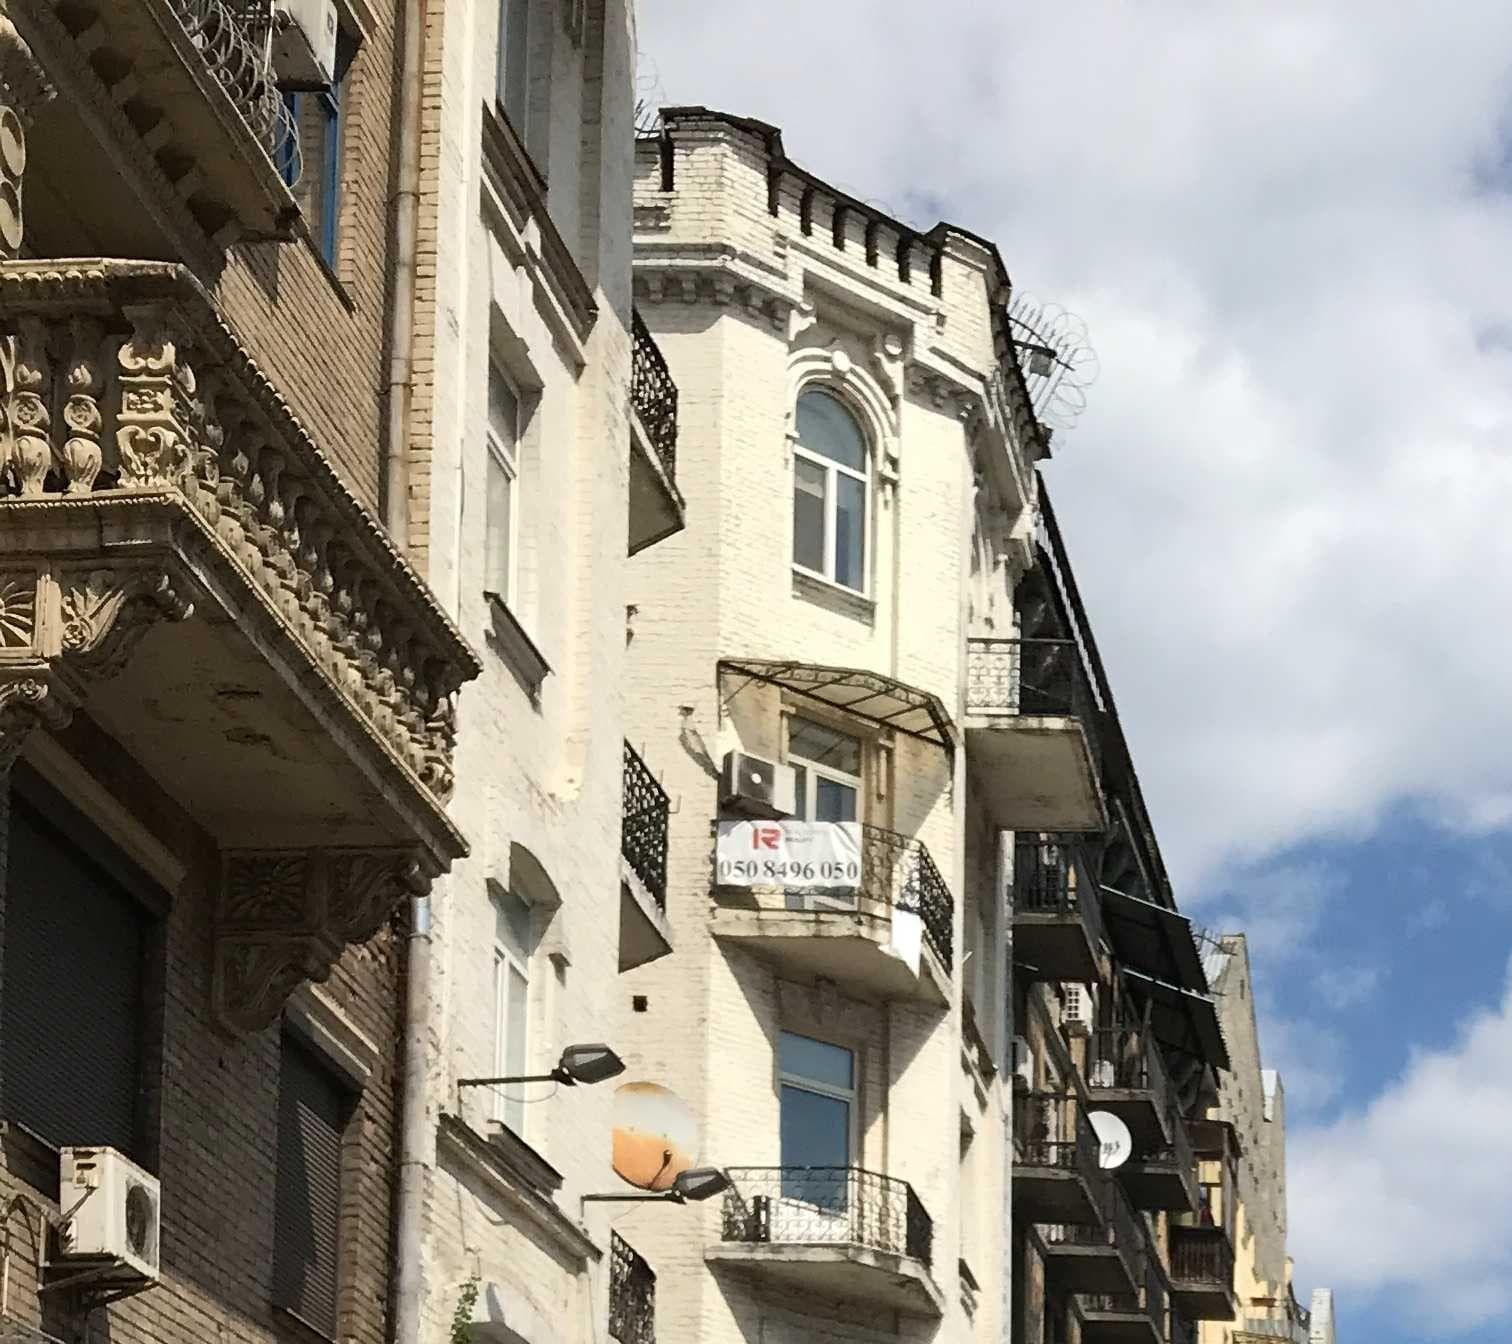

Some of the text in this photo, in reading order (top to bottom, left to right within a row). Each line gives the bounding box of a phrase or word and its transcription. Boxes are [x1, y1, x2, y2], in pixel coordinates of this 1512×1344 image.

[720, 859, 858, 880] 050 8496 050
